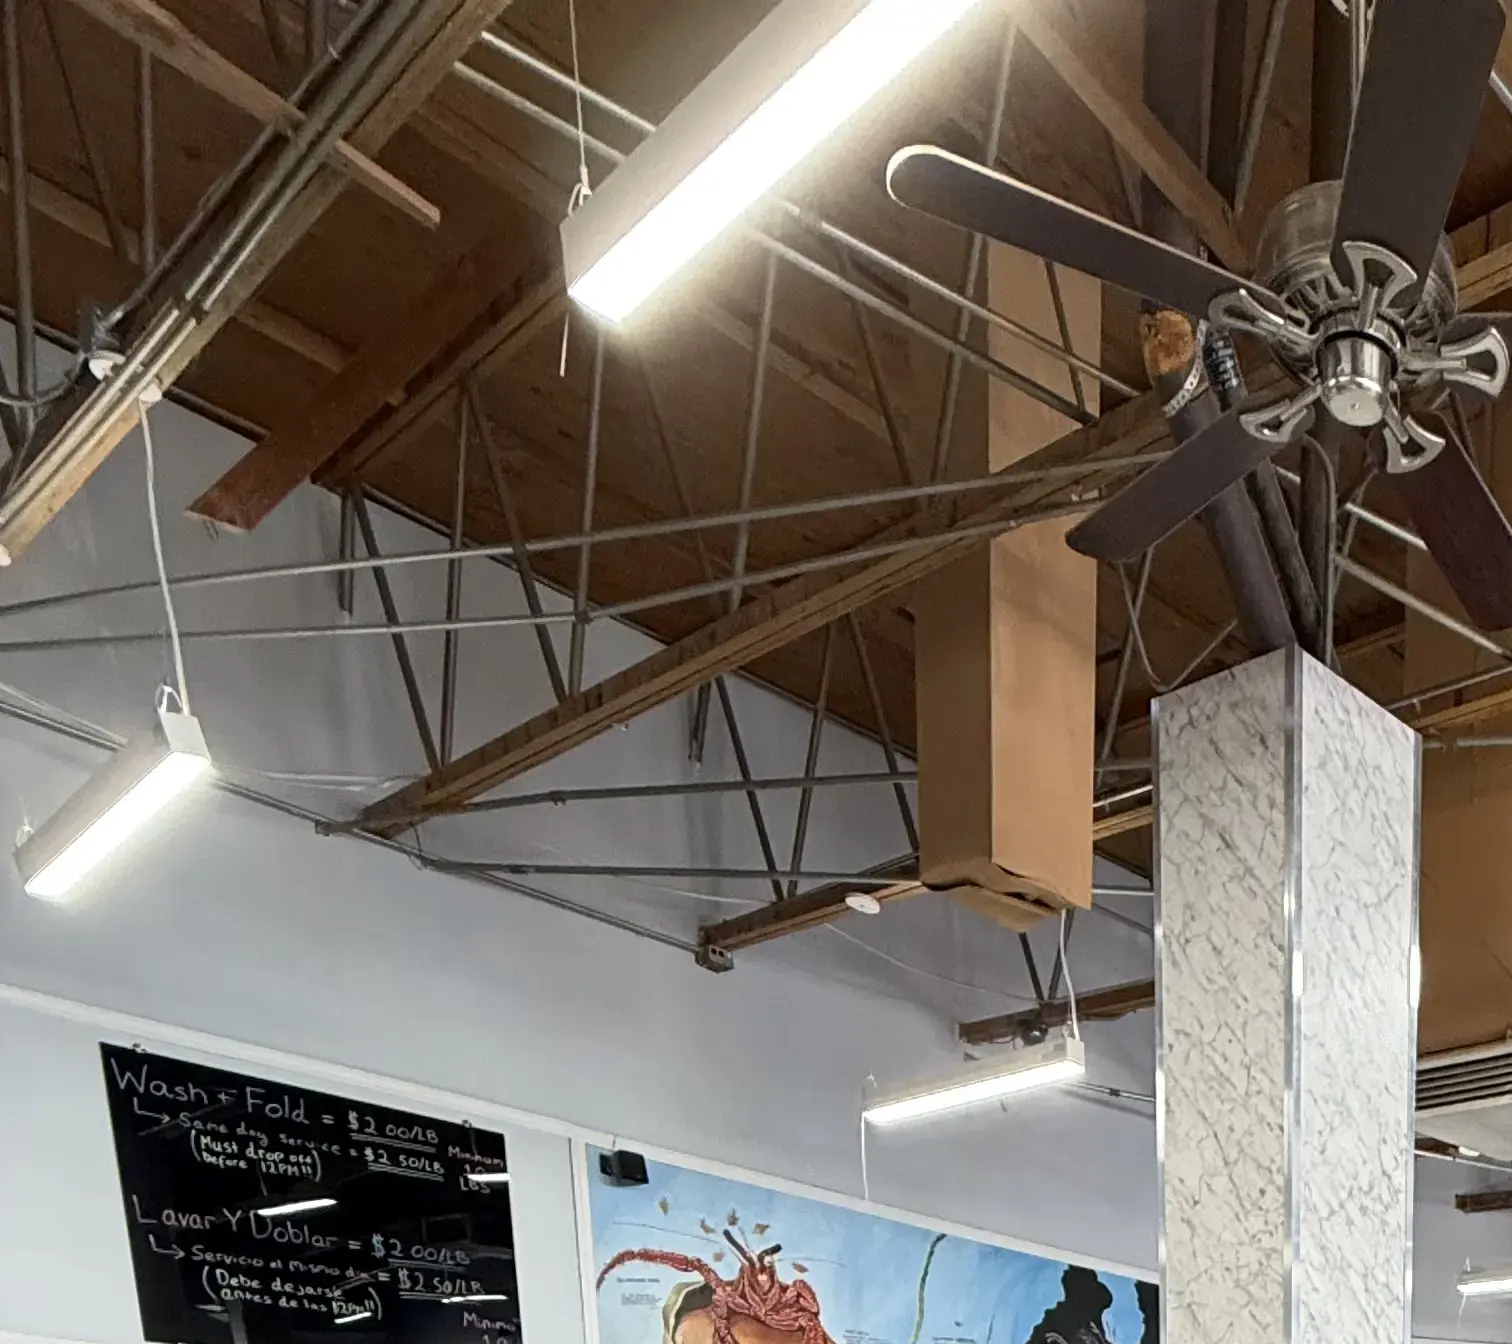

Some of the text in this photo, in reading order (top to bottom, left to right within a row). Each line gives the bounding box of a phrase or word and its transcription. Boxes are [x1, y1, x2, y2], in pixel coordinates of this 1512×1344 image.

[110, 1057, 208, 1104] Wash
[245, 1086, 310, 1124] Fold
[179, 1112, 228, 1133] Same
[236, 1121, 269, 1147] day
[279, 1133, 342, 1155] service
[245, 1142, 285, 1162] drop
[132, 1194, 217, 1229] Lavar
[222, 1208, 242, 1232] Y
[249, 1209, 338, 1248] Doblar
[191, 1245, 264, 1268] Servicio
[220, 1289, 273, 1305] antes
[278, 1296, 298, 1309] de
